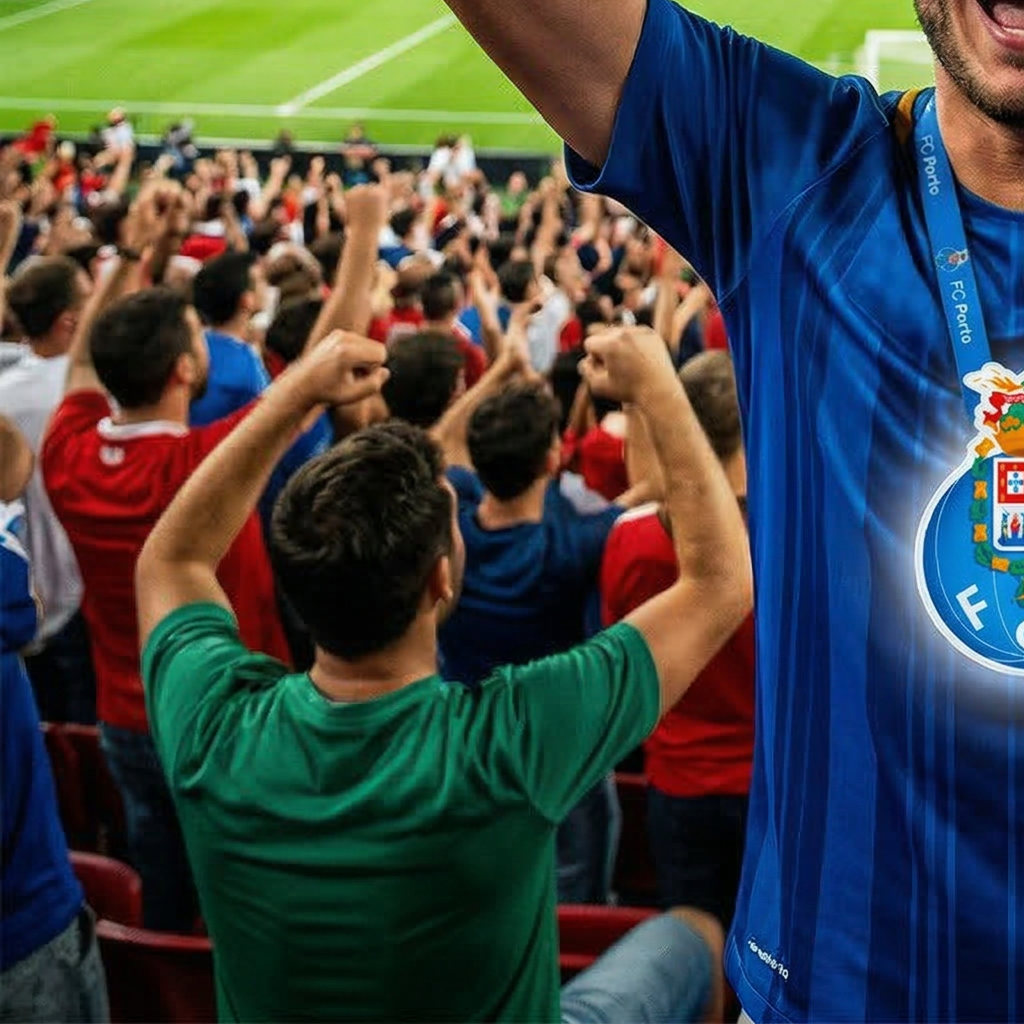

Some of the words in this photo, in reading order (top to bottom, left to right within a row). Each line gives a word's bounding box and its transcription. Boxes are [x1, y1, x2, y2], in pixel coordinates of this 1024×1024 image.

[921, 135, 935, 155] FC
[923, 156, 941, 195] Porto
[950, 280, 966, 301] FC
[955, 303, 972, 344] Porto
